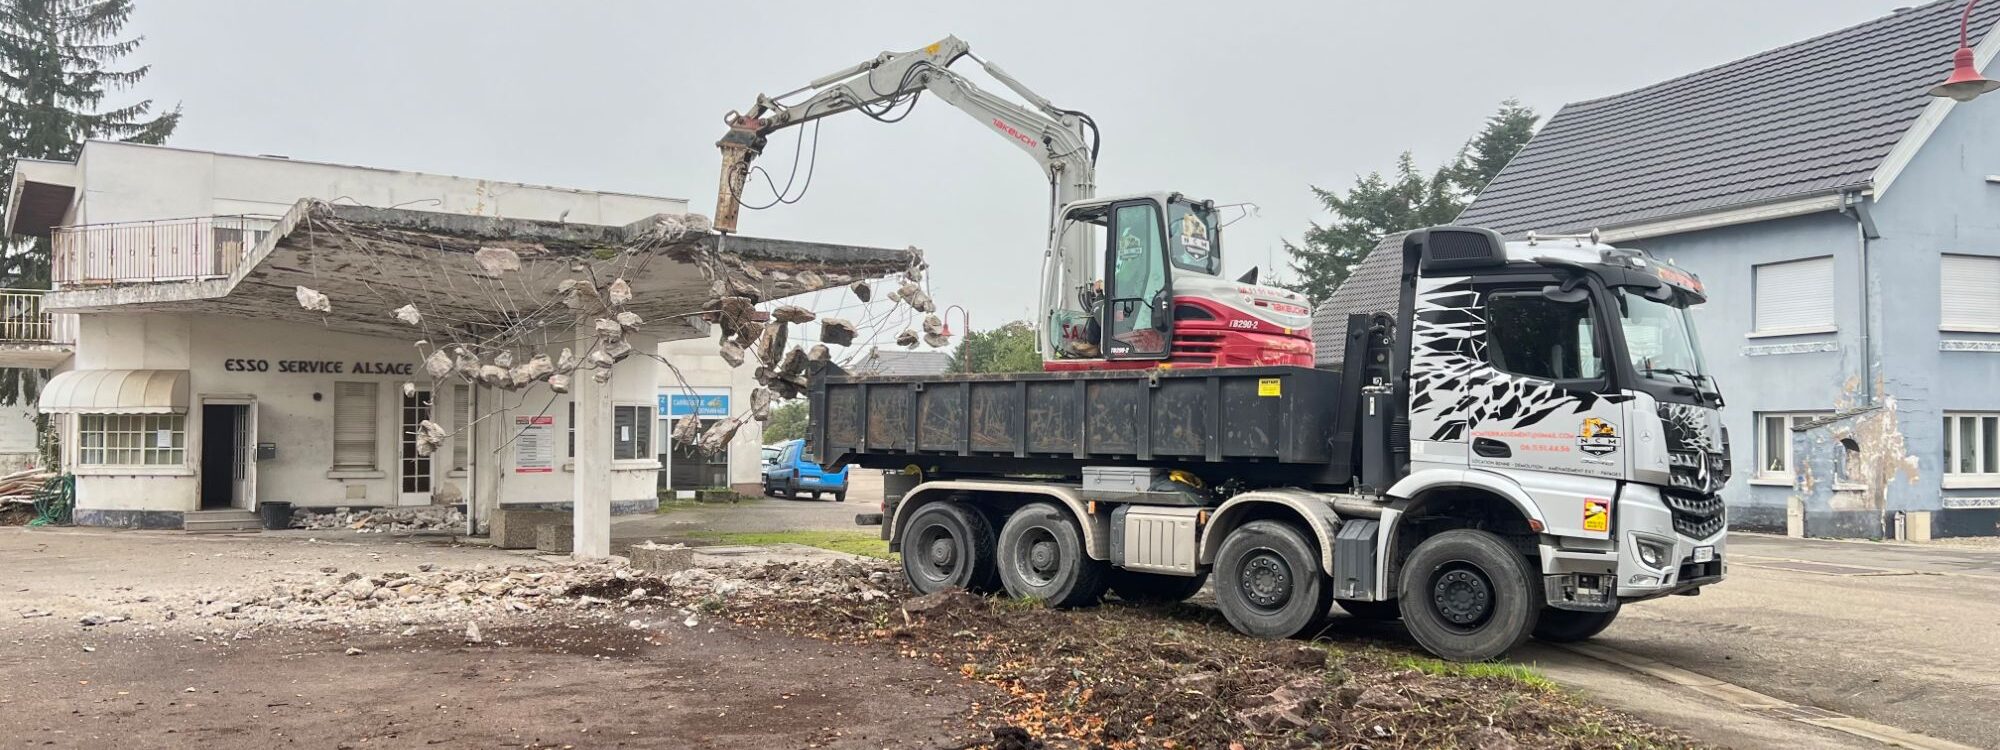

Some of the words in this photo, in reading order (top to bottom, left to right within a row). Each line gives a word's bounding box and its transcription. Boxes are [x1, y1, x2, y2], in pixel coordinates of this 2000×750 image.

[992, 118, 1037, 148] TAKEUCHI
[1229, 320, 1258, 330] TB290-2
[225, 358, 269, 372] ESSO
[278, 360, 343, 374] SERVICE
[352, 362, 413, 375] ALSACE
